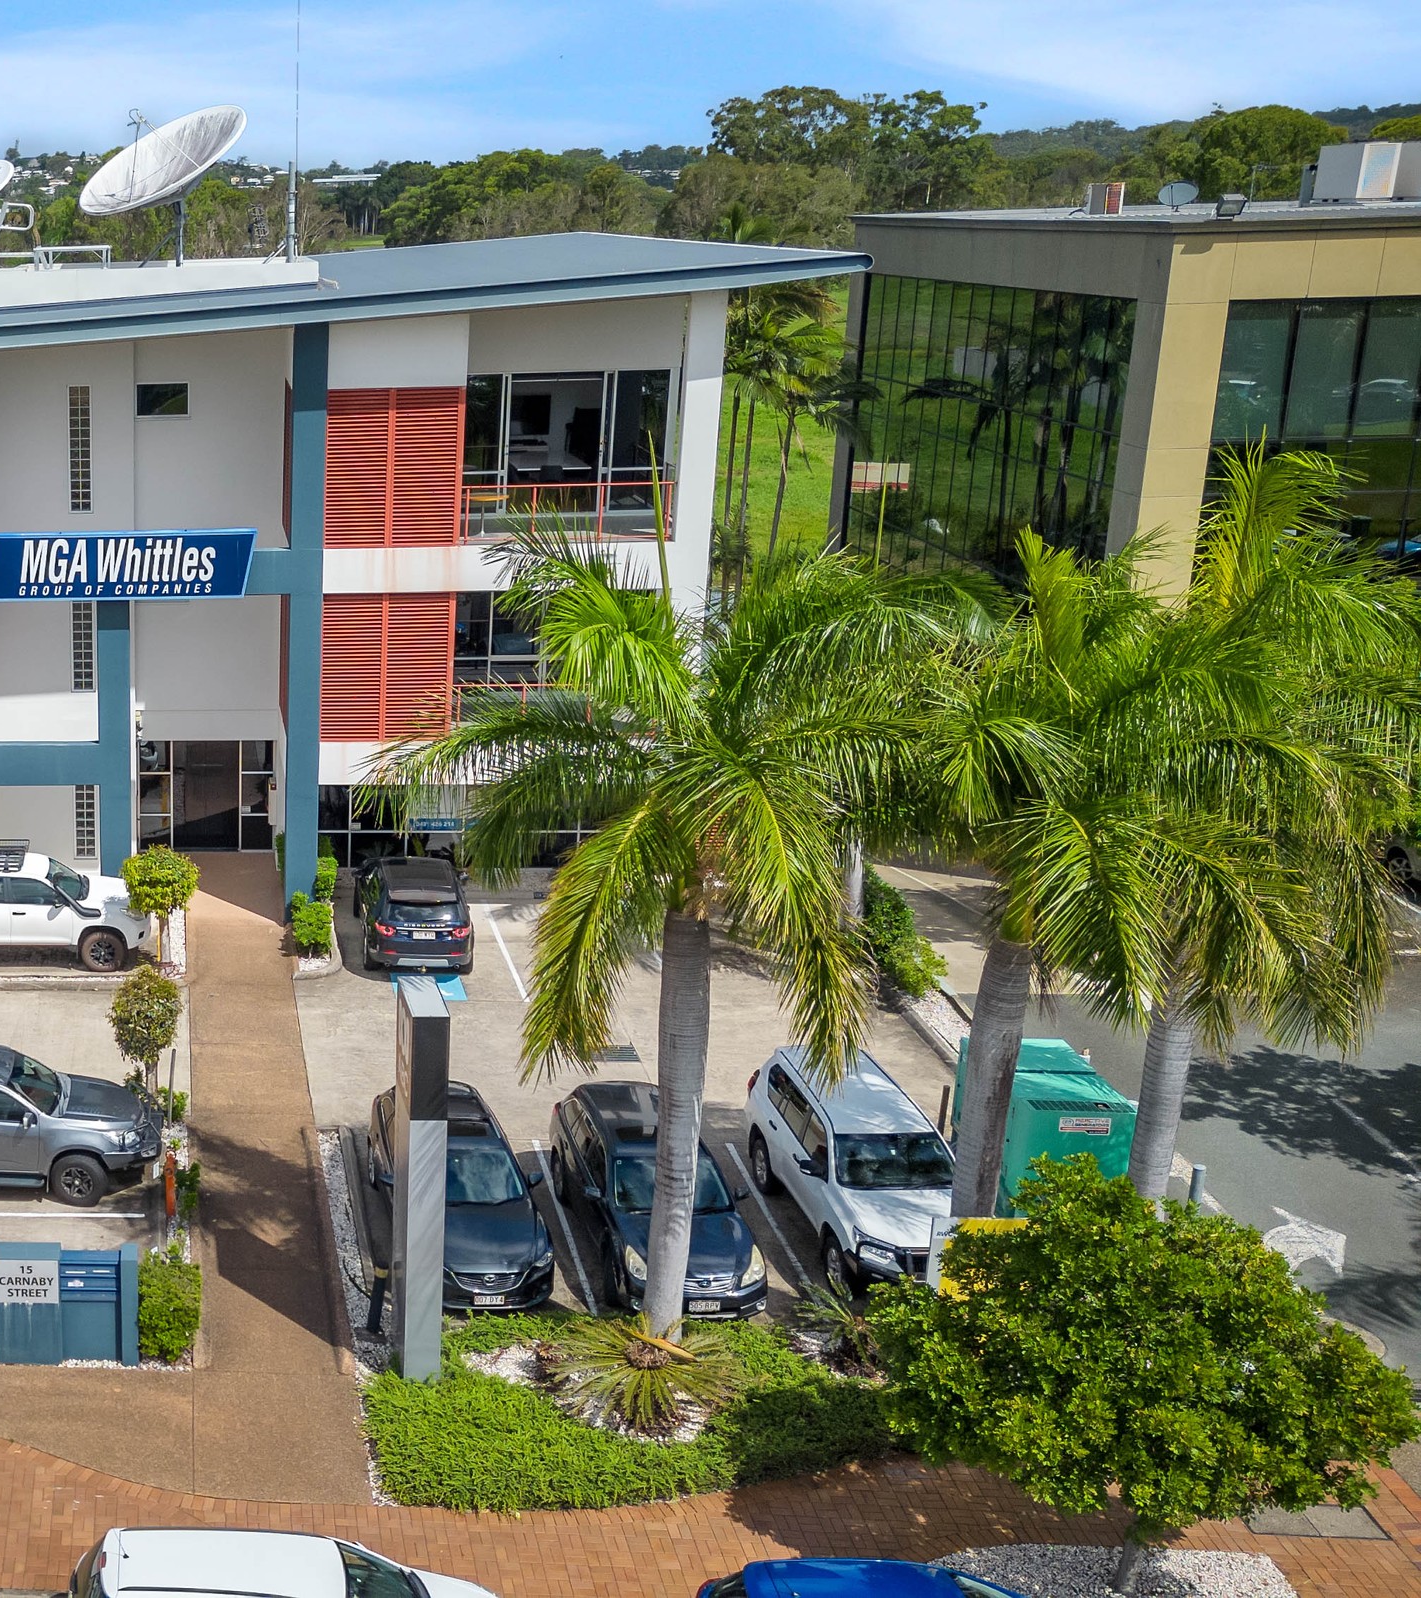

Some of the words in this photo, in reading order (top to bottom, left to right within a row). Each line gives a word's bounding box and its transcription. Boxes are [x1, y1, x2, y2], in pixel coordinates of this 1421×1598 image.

[20, 538, 87, 584] MGA
[96, 537, 216, 583] Whittles
[18, 585, 74, 597] GROUP
[84, 584, 104, 596] OF
[114, 582, 212, 595] COMPANIES
[19, 1265, 33, 1274] 15
[7, 1288, 49, 1298] STREET
